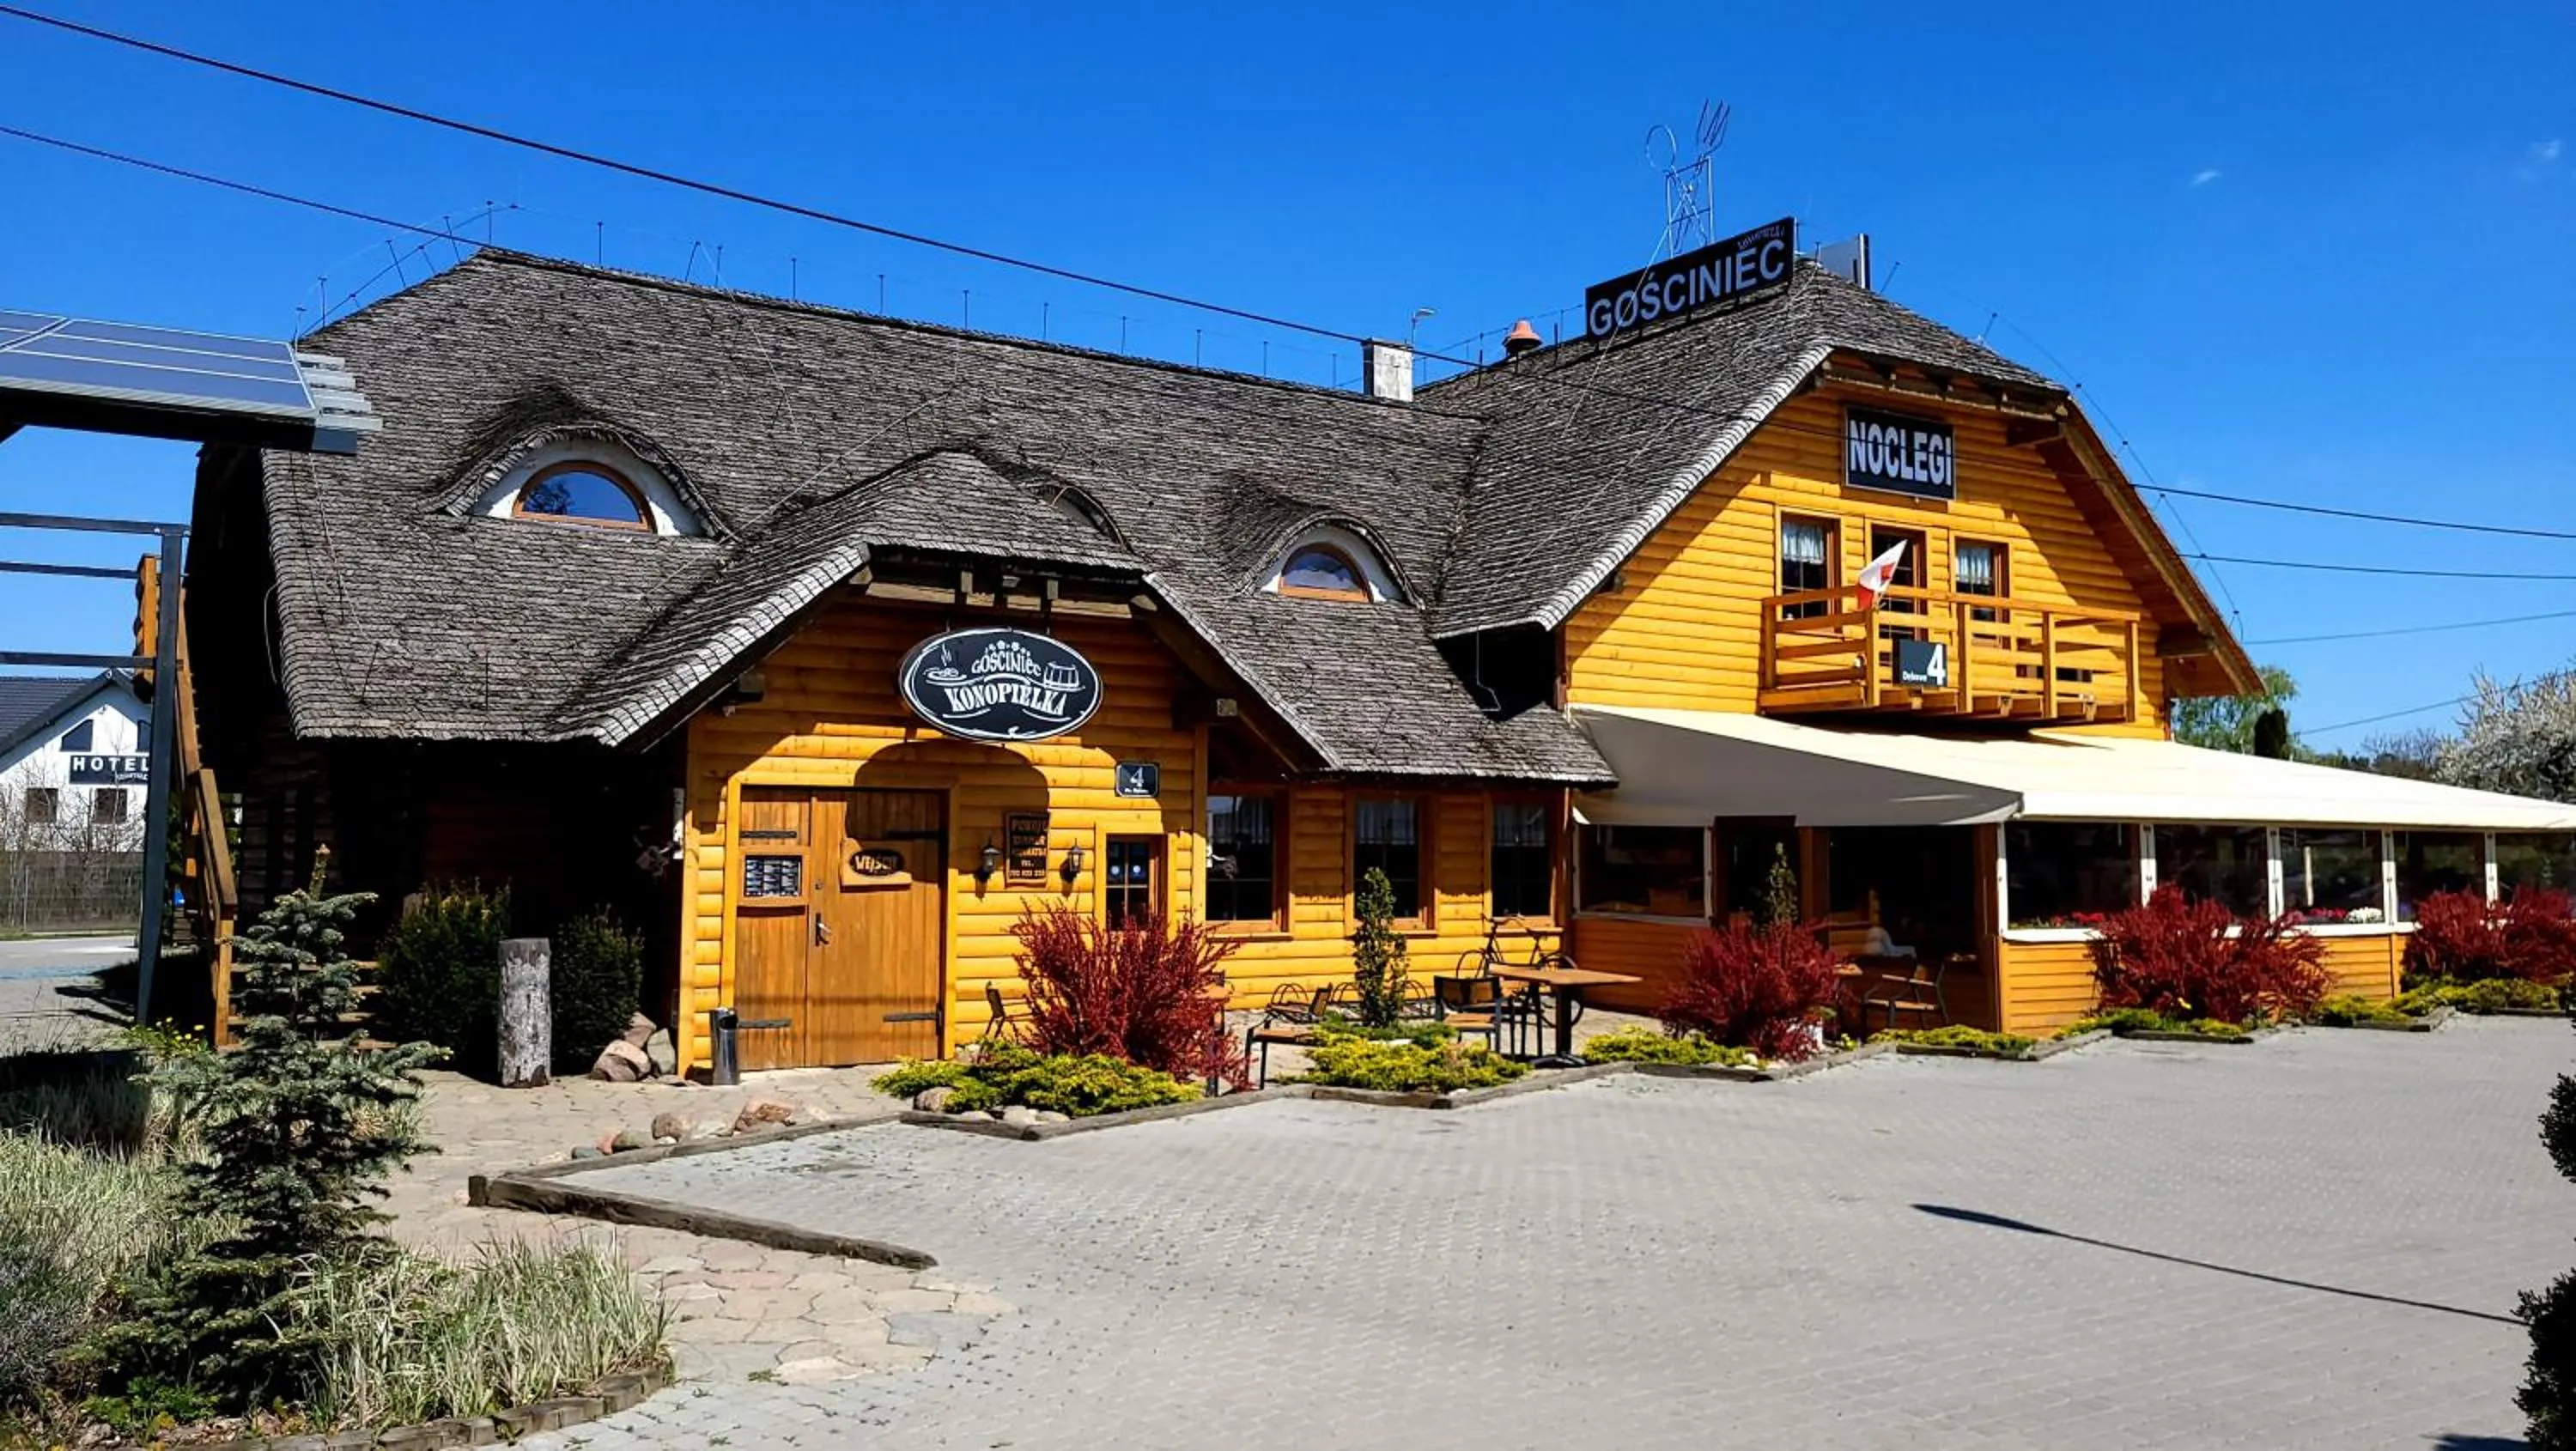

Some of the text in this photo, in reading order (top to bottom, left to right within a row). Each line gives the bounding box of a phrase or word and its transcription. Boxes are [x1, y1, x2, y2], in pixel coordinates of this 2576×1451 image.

[1589, 240, 1785, 337] GOŚCINIEC
[1850, 419, 1952, 486] NOCLEGI
[1927, 644, 1946, 686] 4
[945, 683, 1066, 715] KONOPIELKA
[73, 756, 149, 772] HOTEL
[1130, 767, 1144, 787] 4
